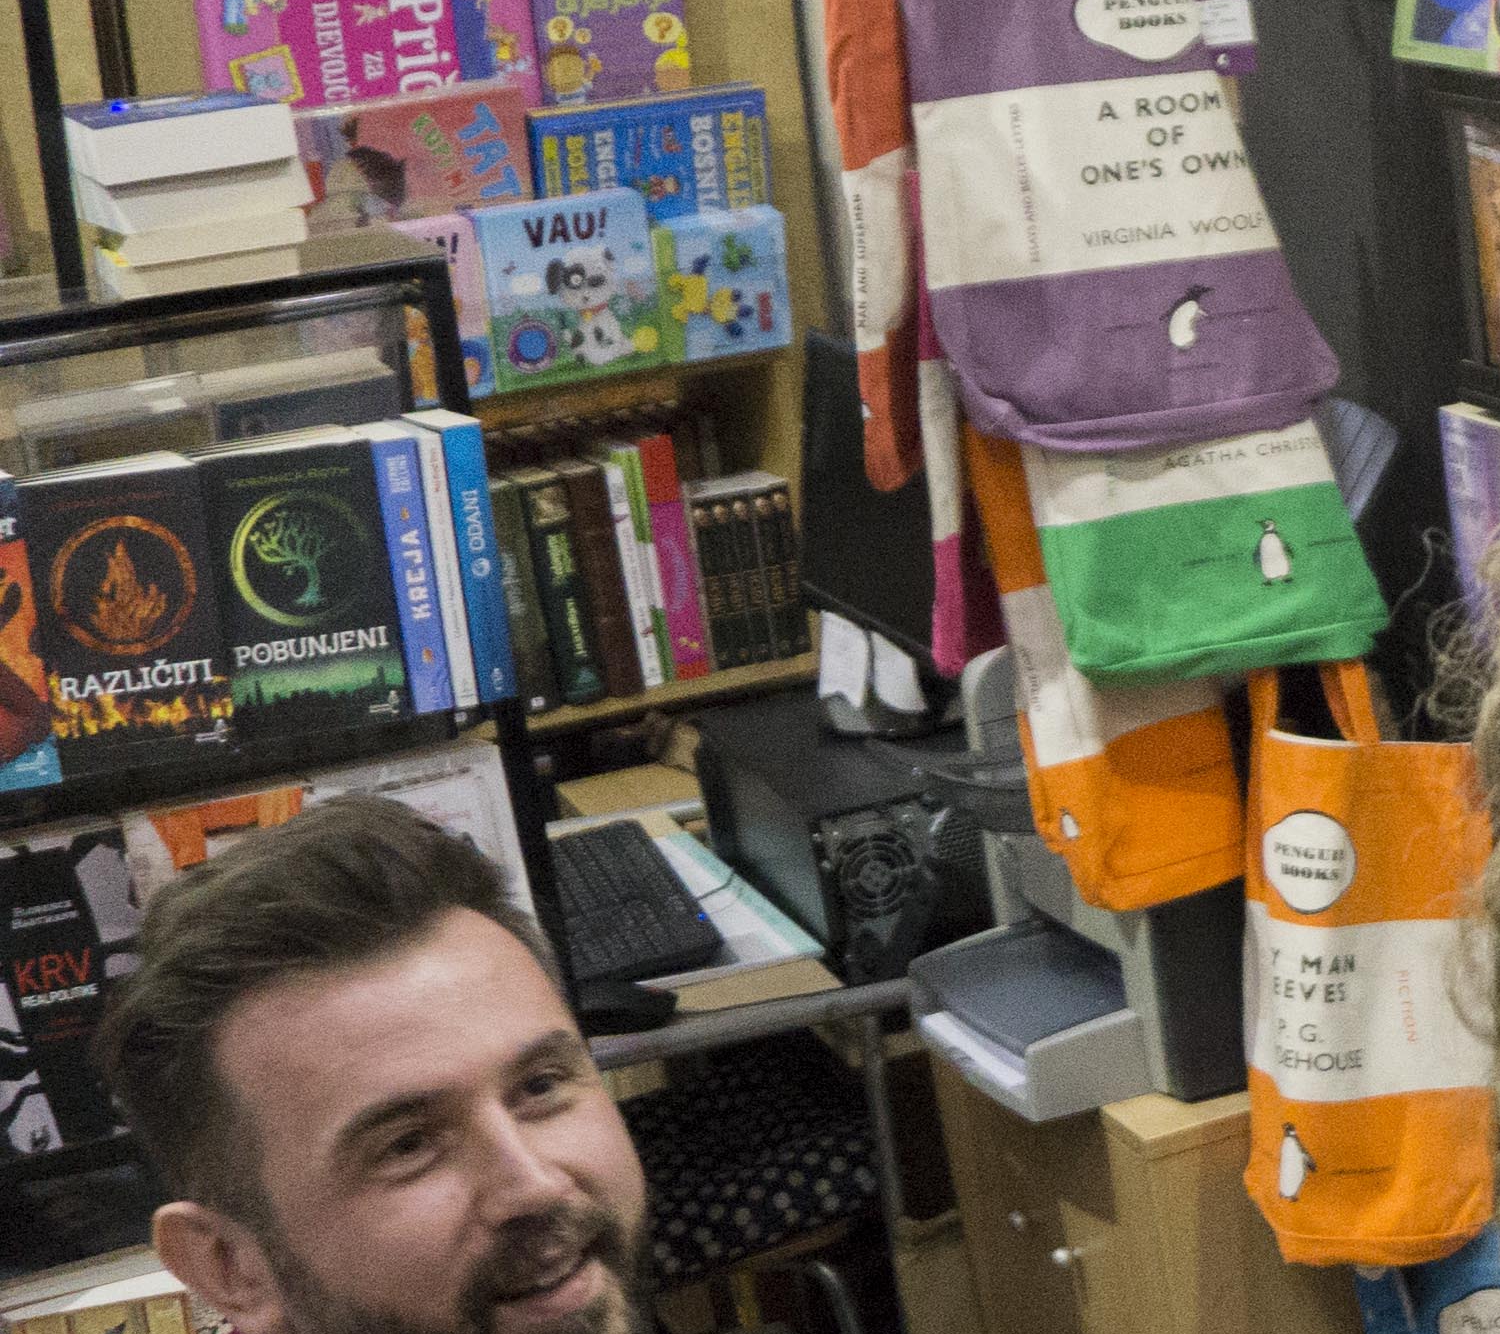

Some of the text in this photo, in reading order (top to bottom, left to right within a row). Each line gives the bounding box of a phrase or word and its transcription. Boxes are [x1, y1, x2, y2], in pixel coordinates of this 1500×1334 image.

[1118, 11, 1188, 31] BOOKS
[362, 51, 386, 81] za
[1096, 90, 1222, 121] A ROOM
[1146, 124, 1185, 148] OF
[1080, 156, 1164, 186] ONE'S
[522, 208, 608, 249] VAU!
[1082, 222, 1176, 248] VIRGINIA
[855, 300, 868, 329] MAN
[1163, 449, 1248, 470] AGATHA
[461, 488, 486, 553] ODANI
[400, 529, 432, 621] KREJA
[233, 624, 389, 667] POBUNJENI
[60, 657, 214, 701] RAZLIČITI
[1280, 862, 1341, 881] BOOKS
[14, 947, 92, 994] KRV
[1300, 954, 1356, 975] MAN
[1396, 969, 1418, 1043] FICTION
[1297, 1023, 1326, 1044] G.
